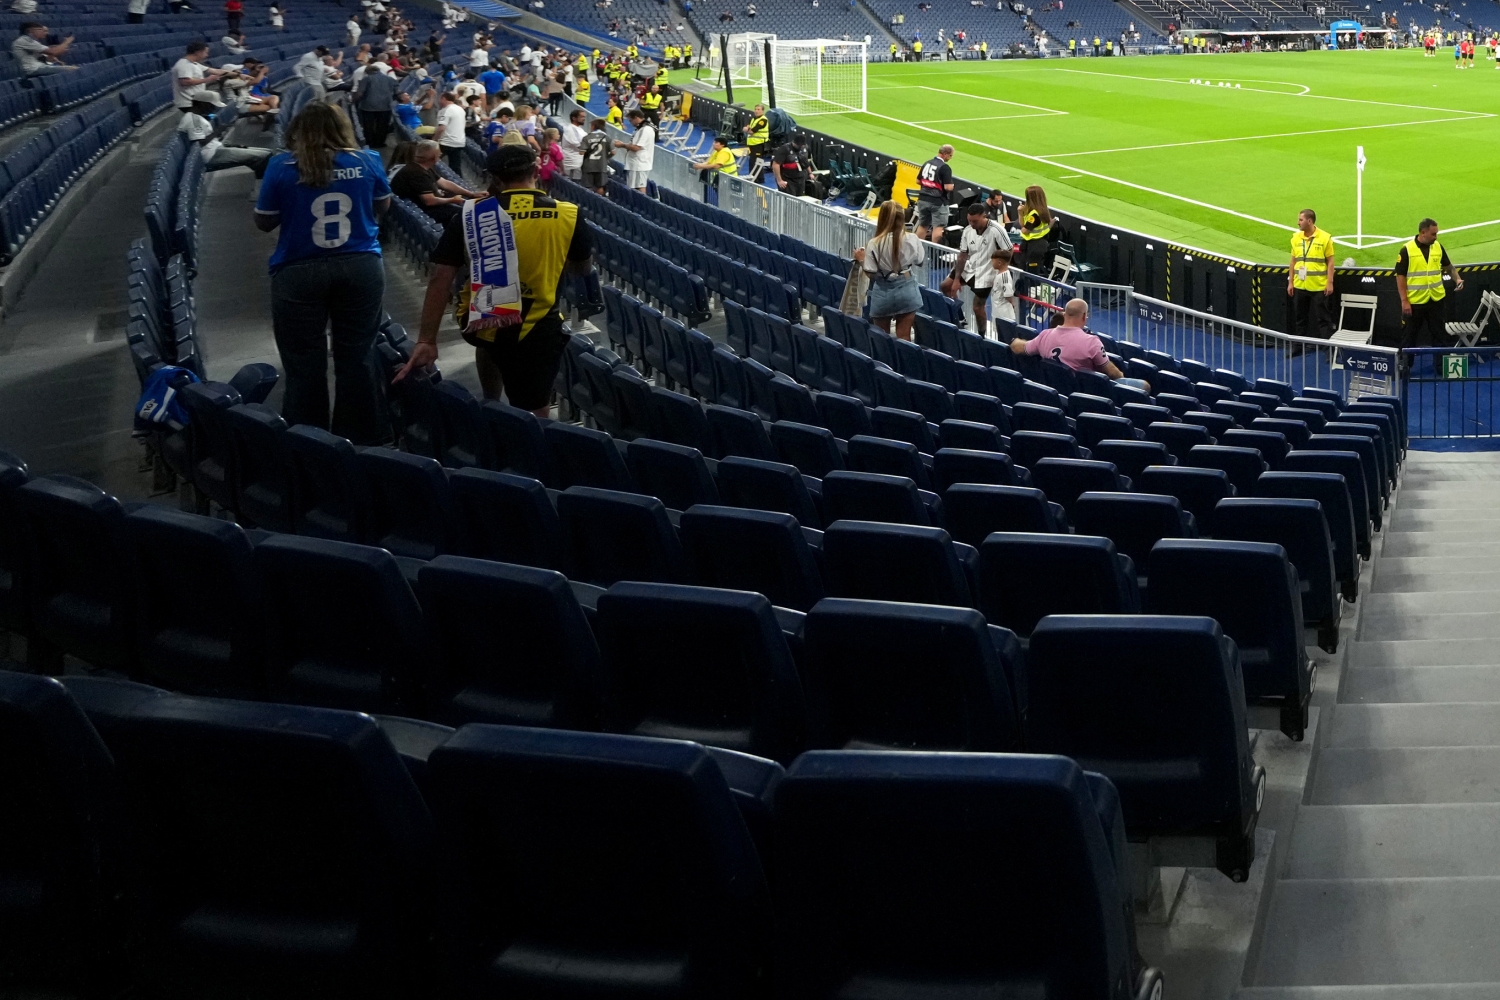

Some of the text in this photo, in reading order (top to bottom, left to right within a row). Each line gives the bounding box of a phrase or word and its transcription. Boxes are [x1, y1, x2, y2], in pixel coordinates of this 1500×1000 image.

[589, 144, 602, 160] 2
[921, 163, 937, 181] 45
[310, 192, 353, 249] 8
[478, 210, 504, 273] MADRID
[1139, 308, 1148, 318] 111
[1373, 362, 1388, 372] 109
